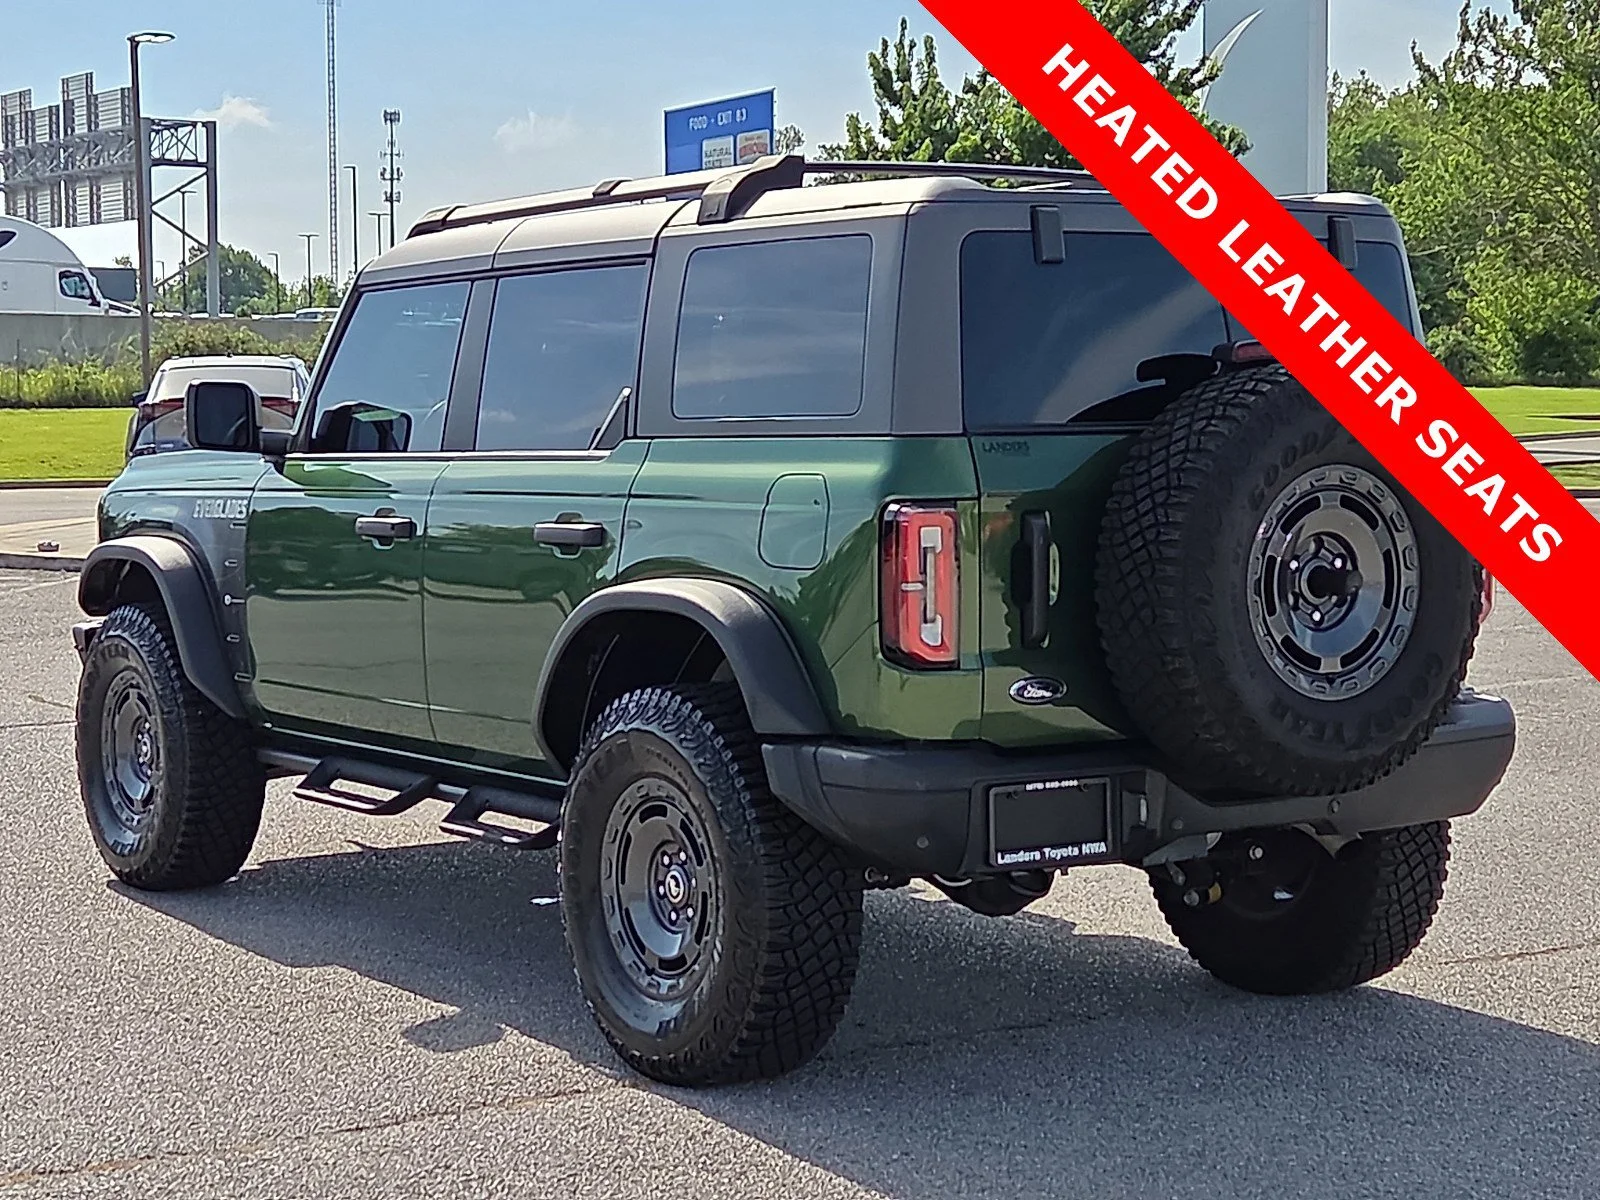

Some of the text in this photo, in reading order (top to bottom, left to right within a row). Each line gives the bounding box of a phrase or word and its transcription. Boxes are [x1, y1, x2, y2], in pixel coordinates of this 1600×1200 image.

[689, 115, 708, 132] FOOD
[717, 110, 733, 126] EXIT
[982, 440, 1030, 453] LANDERS
[192, 498, 248, 519] EVERGLADES
[1023, 683, 1053, 698] Ford
[997, 842, 1107, 865] Landers Toyota NWA
